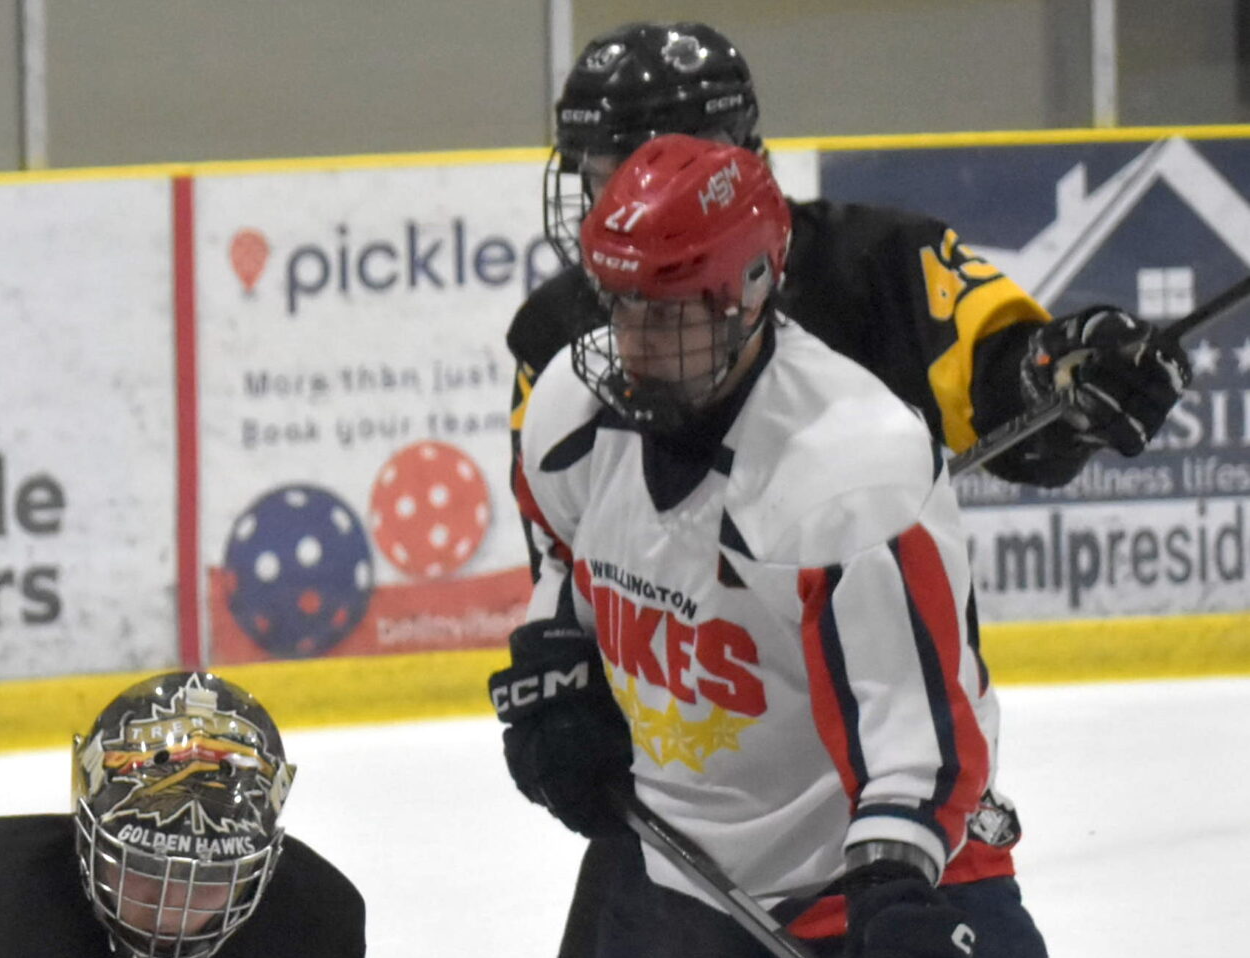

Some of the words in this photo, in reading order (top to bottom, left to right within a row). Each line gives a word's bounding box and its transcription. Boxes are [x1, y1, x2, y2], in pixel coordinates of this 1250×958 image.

[561, 109, 601, 123] CCM
[592, 251, 639, 272] CCM
[243, 370, 328, 398] More
[338, 363, 420, 393] than
[242, 417, 320, 450] Book
[335, 415, 411, 448] your
[966, 503, 1246, 608] .mlpresid
[589, 558, 698, 621] WELLINGTON
[492, 661, 589, 713] CCM
[118, 823, 191, 853] GOLDEN
[196, 836, 256, 856] HAWKS
